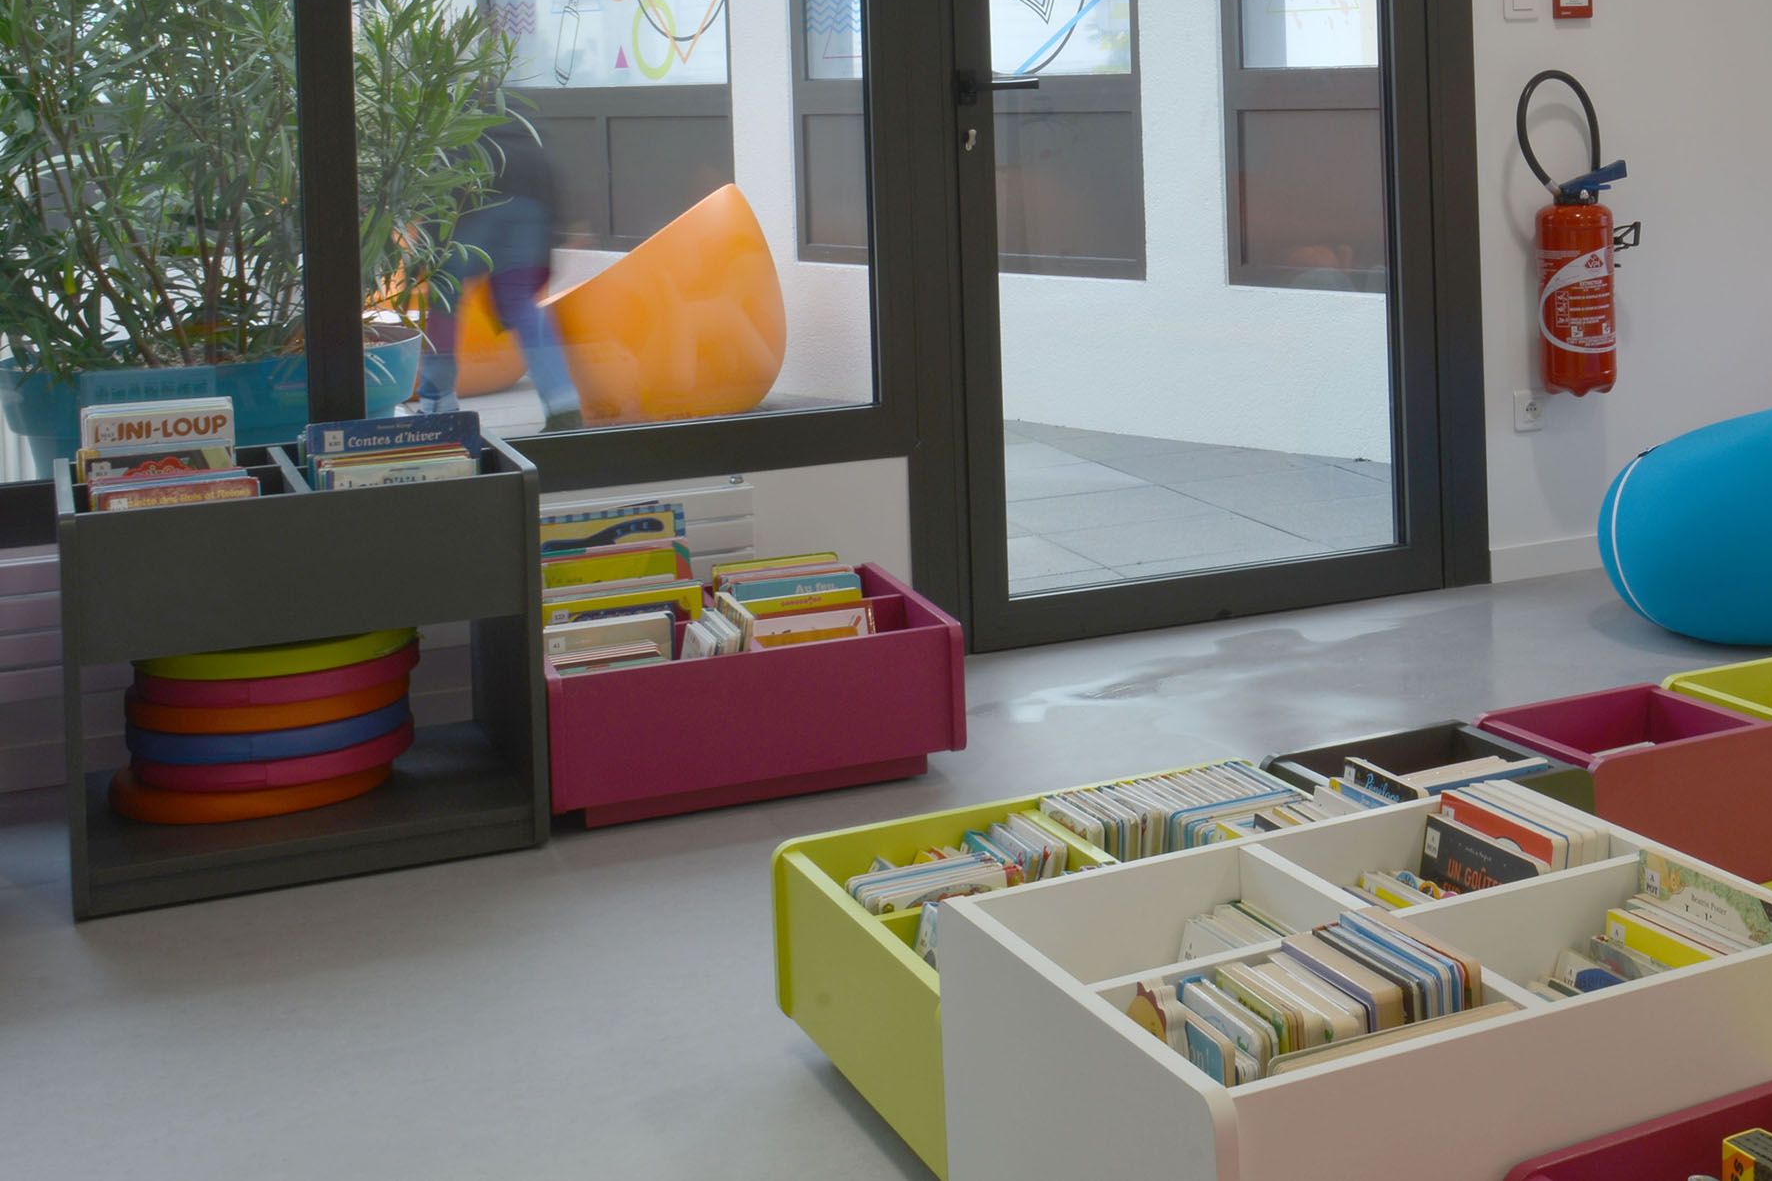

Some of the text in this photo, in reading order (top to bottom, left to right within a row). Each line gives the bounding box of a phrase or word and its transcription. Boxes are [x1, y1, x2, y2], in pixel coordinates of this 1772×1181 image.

[95, 414, 228, 444] INI-LOUP
[348, 435, 391, 448] Contes
[394, 431, 442, 444] d'hiver
[1448, 858, 1462, 882] UN
[1646, 884, 1658, 895] POT
[1710, 901, 1728, 915] Potter
